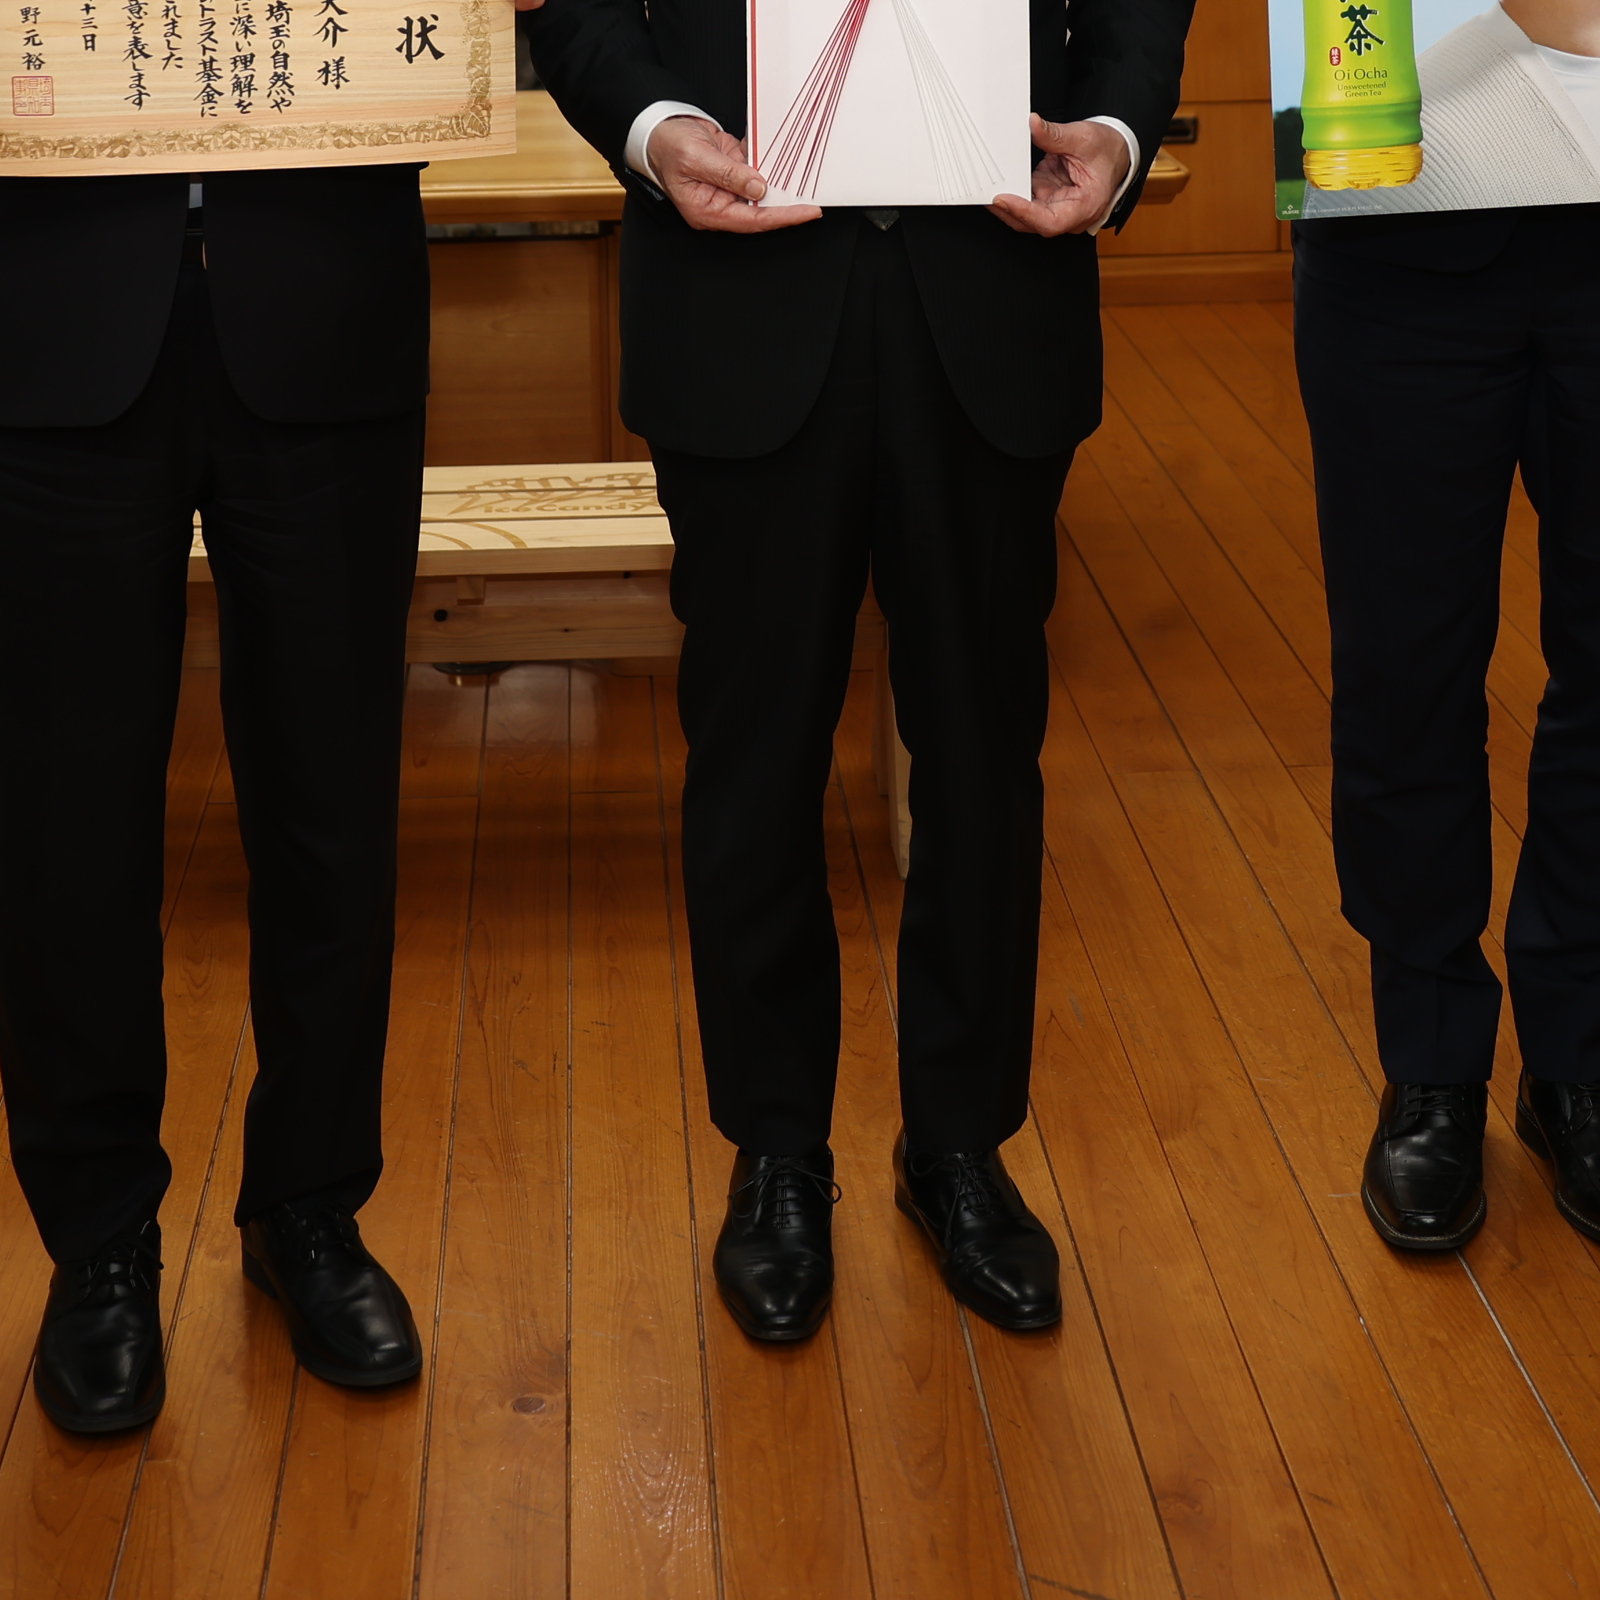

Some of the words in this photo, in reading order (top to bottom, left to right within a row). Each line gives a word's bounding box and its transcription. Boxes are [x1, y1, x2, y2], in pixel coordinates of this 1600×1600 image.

[1334, 69, 1351, 81] Oi
[1353, 67, 1388, 81] Ocha
[1337, 81, 1387, 91] Unsweetened
[1344, 89, 1369, 98] Green
[1369, 89, 1382, 97] Tea
